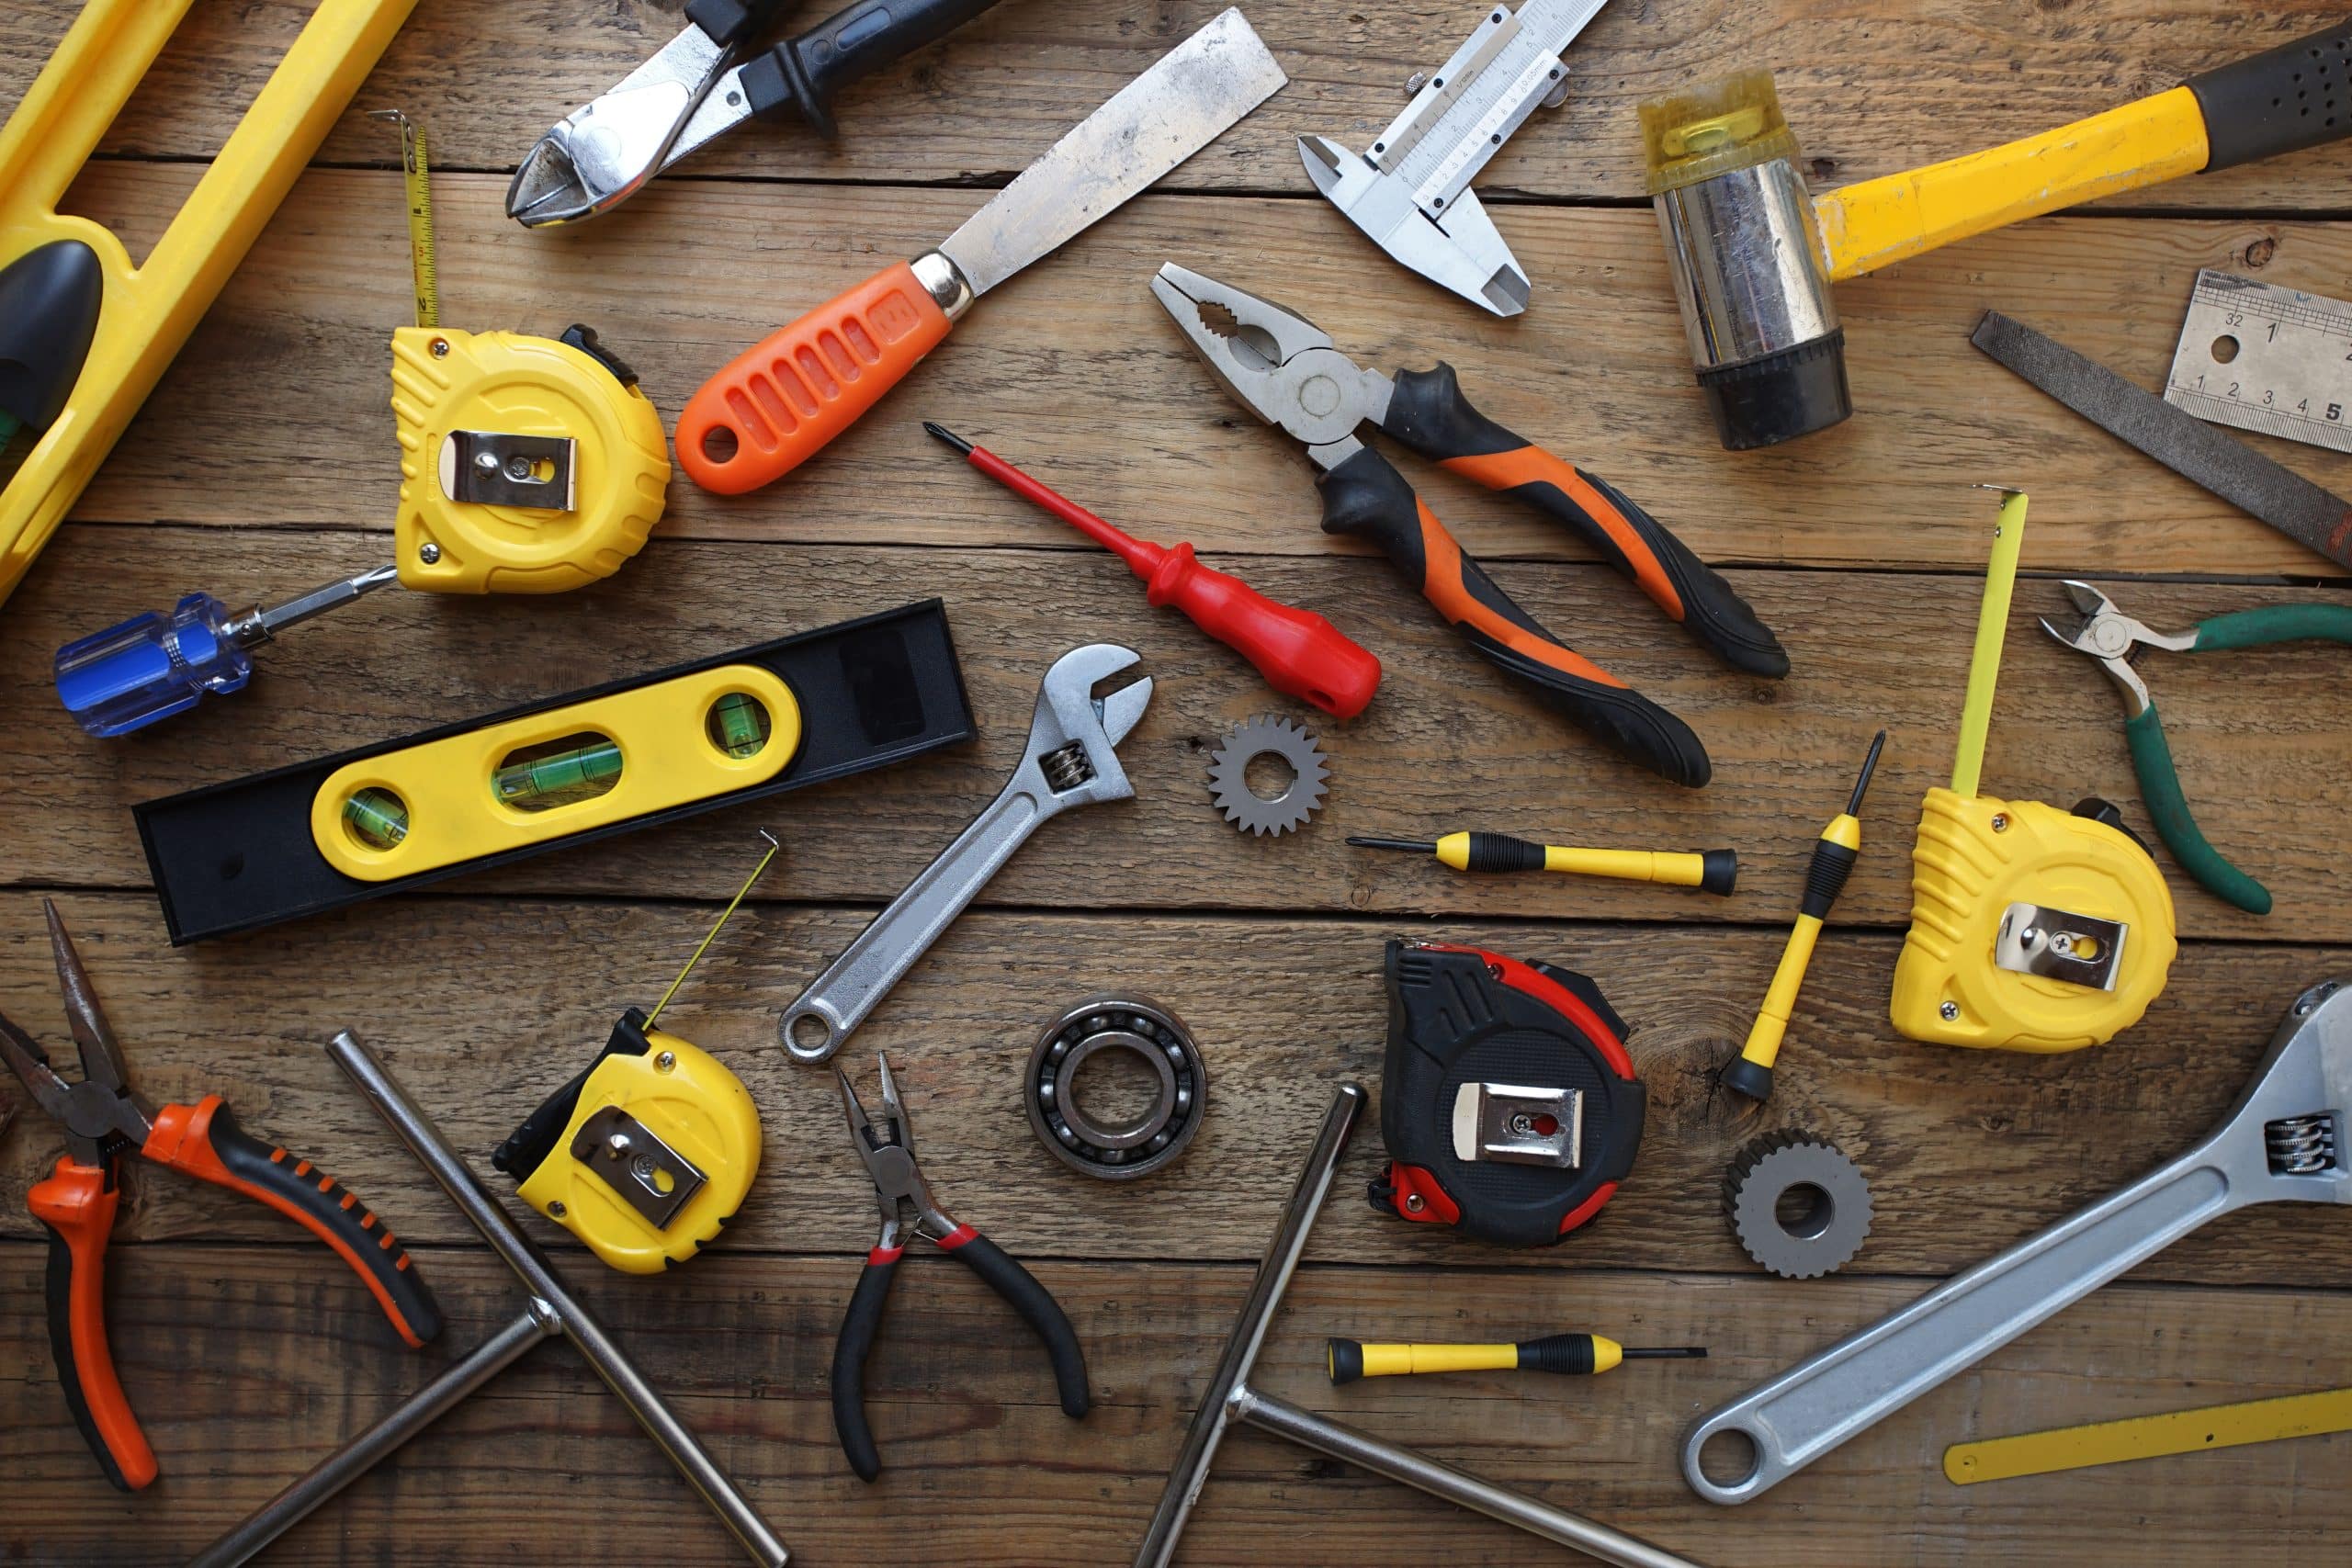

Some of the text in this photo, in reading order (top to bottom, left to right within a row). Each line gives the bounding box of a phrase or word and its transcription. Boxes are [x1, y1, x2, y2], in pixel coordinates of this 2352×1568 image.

[418, 297, 427, 311] 2
[2225, 313, 2243, 327] 32
[2267, 323, 2277, 343] 1
[2197, 374, 2342, 420] 1 2 3 4 5
